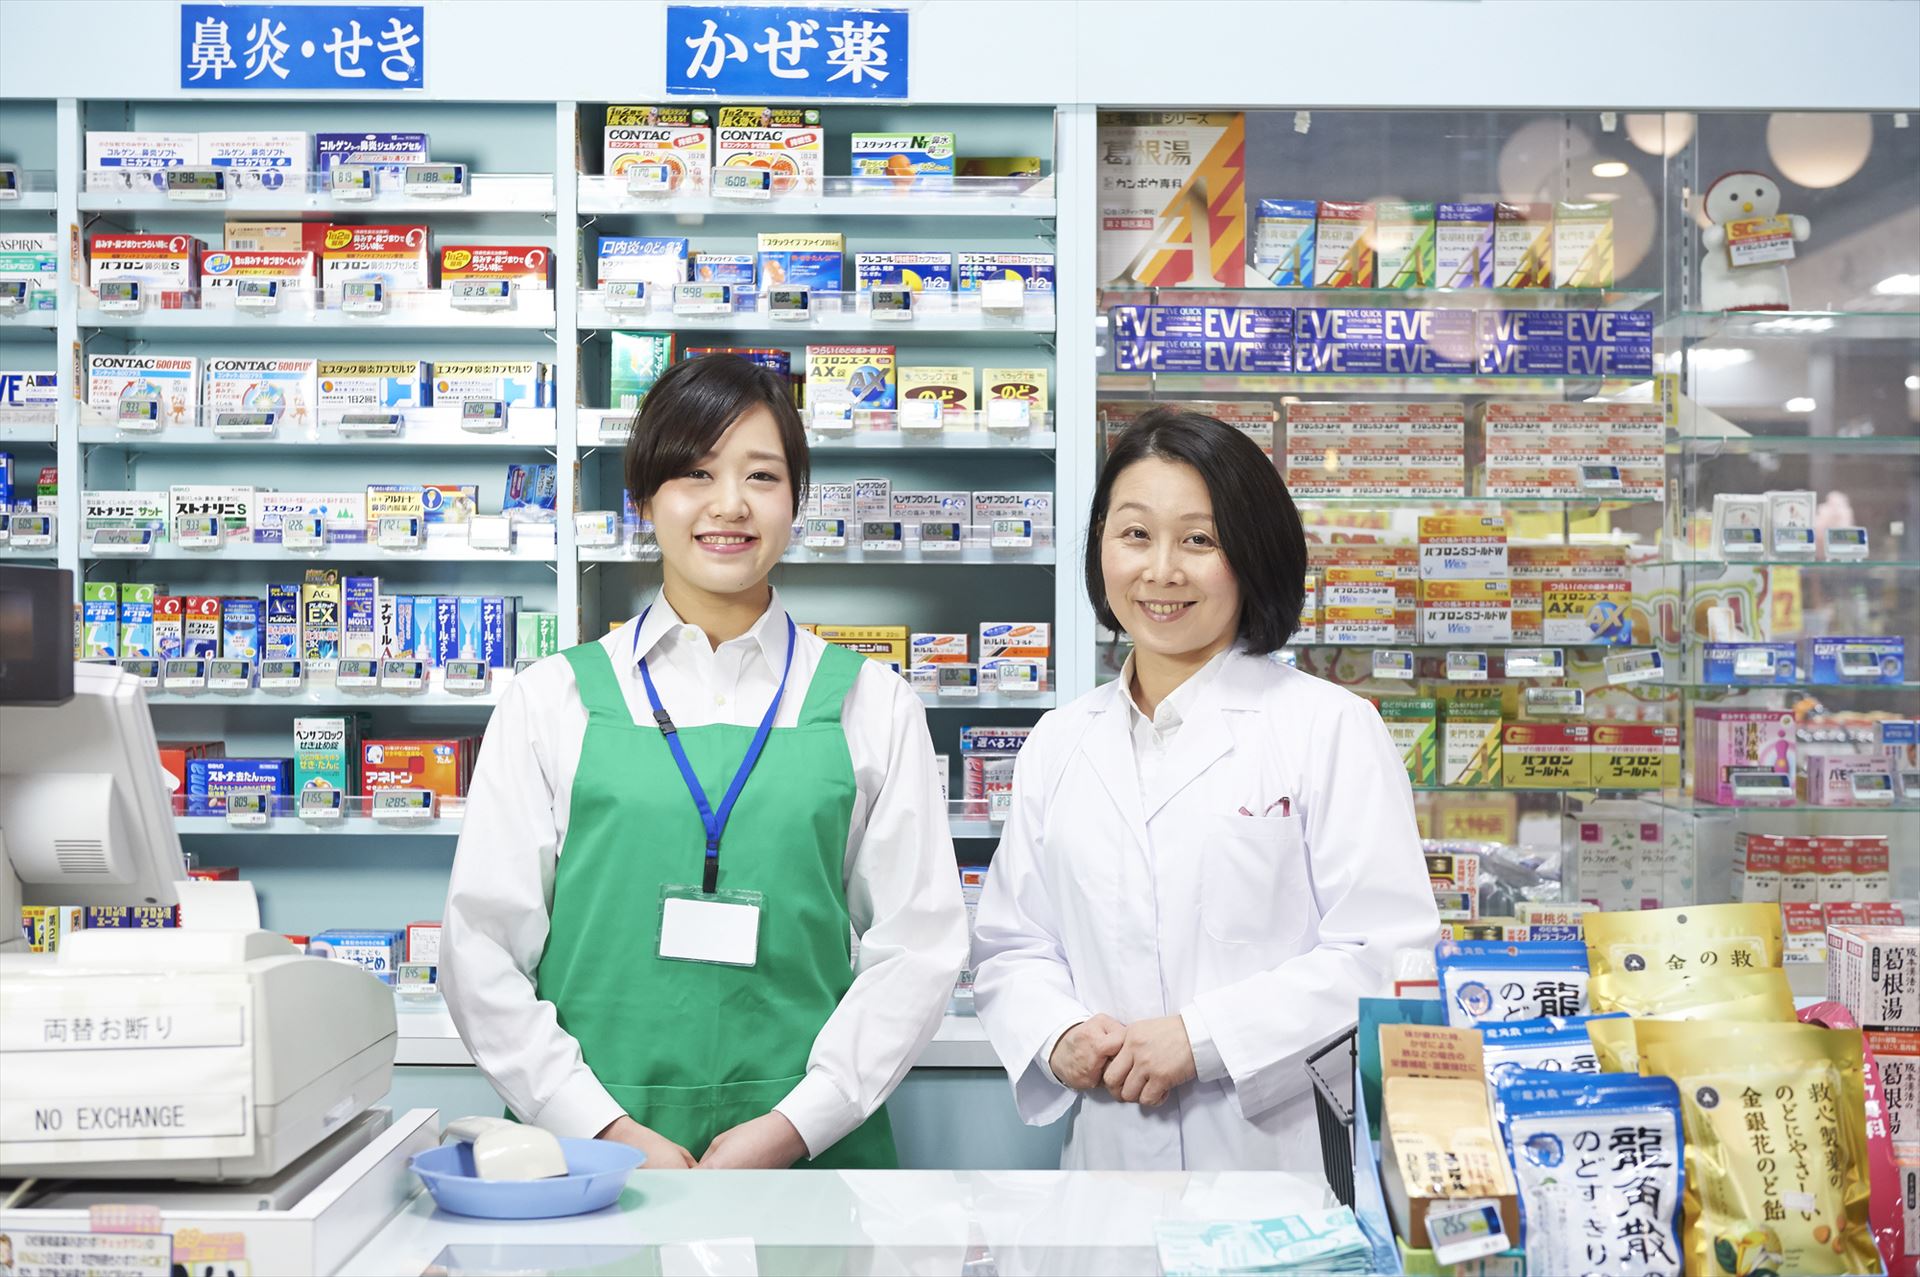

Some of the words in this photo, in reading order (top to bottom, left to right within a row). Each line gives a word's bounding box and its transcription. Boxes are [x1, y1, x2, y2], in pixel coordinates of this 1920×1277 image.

[187, 16, 420, 82] 鼻炎・せき
[685, 19, 890, 81] かぜ薬
[609, 130, 671, 141] CONTAC
[721, 130, 783, 141] CONTAC
[1103, 140, 1192, 166] 葛根湯
[169, 173, 194, 183] 2198
[416, 173, 439, 183] 1188
[725, 176, 746, 186] 1608
[463, 287, 485, 296] 1219
[682, 288, 702, 298] 998
[1115, 308, 1166, 336] EVE
[1205, 309, 1255, 338] EVE
[1298, 310, 1346, 339] EVE
[1386, 311, 1434, 340] EVE
[1480, 313, 1528, 341] EVE
[1567, 313, 1616, 341] EVE
[92, 358, 155, 369] CONTAC
[1116, 341, 1166, 369] EVE
[1205, 342, 1255, 371] EVE
[1297, 343, 1346, 372] EVE
[1386, 344, 1434, 373] EVE
[1479, 345, 1528, 373] EVE
[1567, 346, 1616, 374] EVE
[214, 360, 277, 371] CONTAC
[1000, 386, 1031, 399] のど
[87, 507, 134, 516] ストナリニ
[312, 590, 330, 598] AG
[308, 609, 334, 622] EX
[348, 618, 372, 626] MOIST
[381, 603, 392, 646] ナザール
[296, 730, 343, 740] ベンザブロック
[436, 756, 451, 764] たん
[1522, 756, 1573, 765] パブロン
[1610, 756, 1661, 765] パブロン
[365, 771, 413, 784] アネトン
[1525, 767, 1569, 777] ゴールドA
[1613, 767, 1657, 777] ゴールドA
[385, 797, 406, 807] 1285
[1882, 947, 1905, 1022] 葛根湯
[43, 1016, 175, 1044] 両替お断り
[35, 1109, 62, 1132] NO
[77, 1105, 186, 1130] EXCHANGE
[1740, 1086, 1786, 1222] 金銀花のど飴
[1573, 1131, 1607, 1267] のどすきり
[1609, 1127, 1677, 1265] 龍角散
